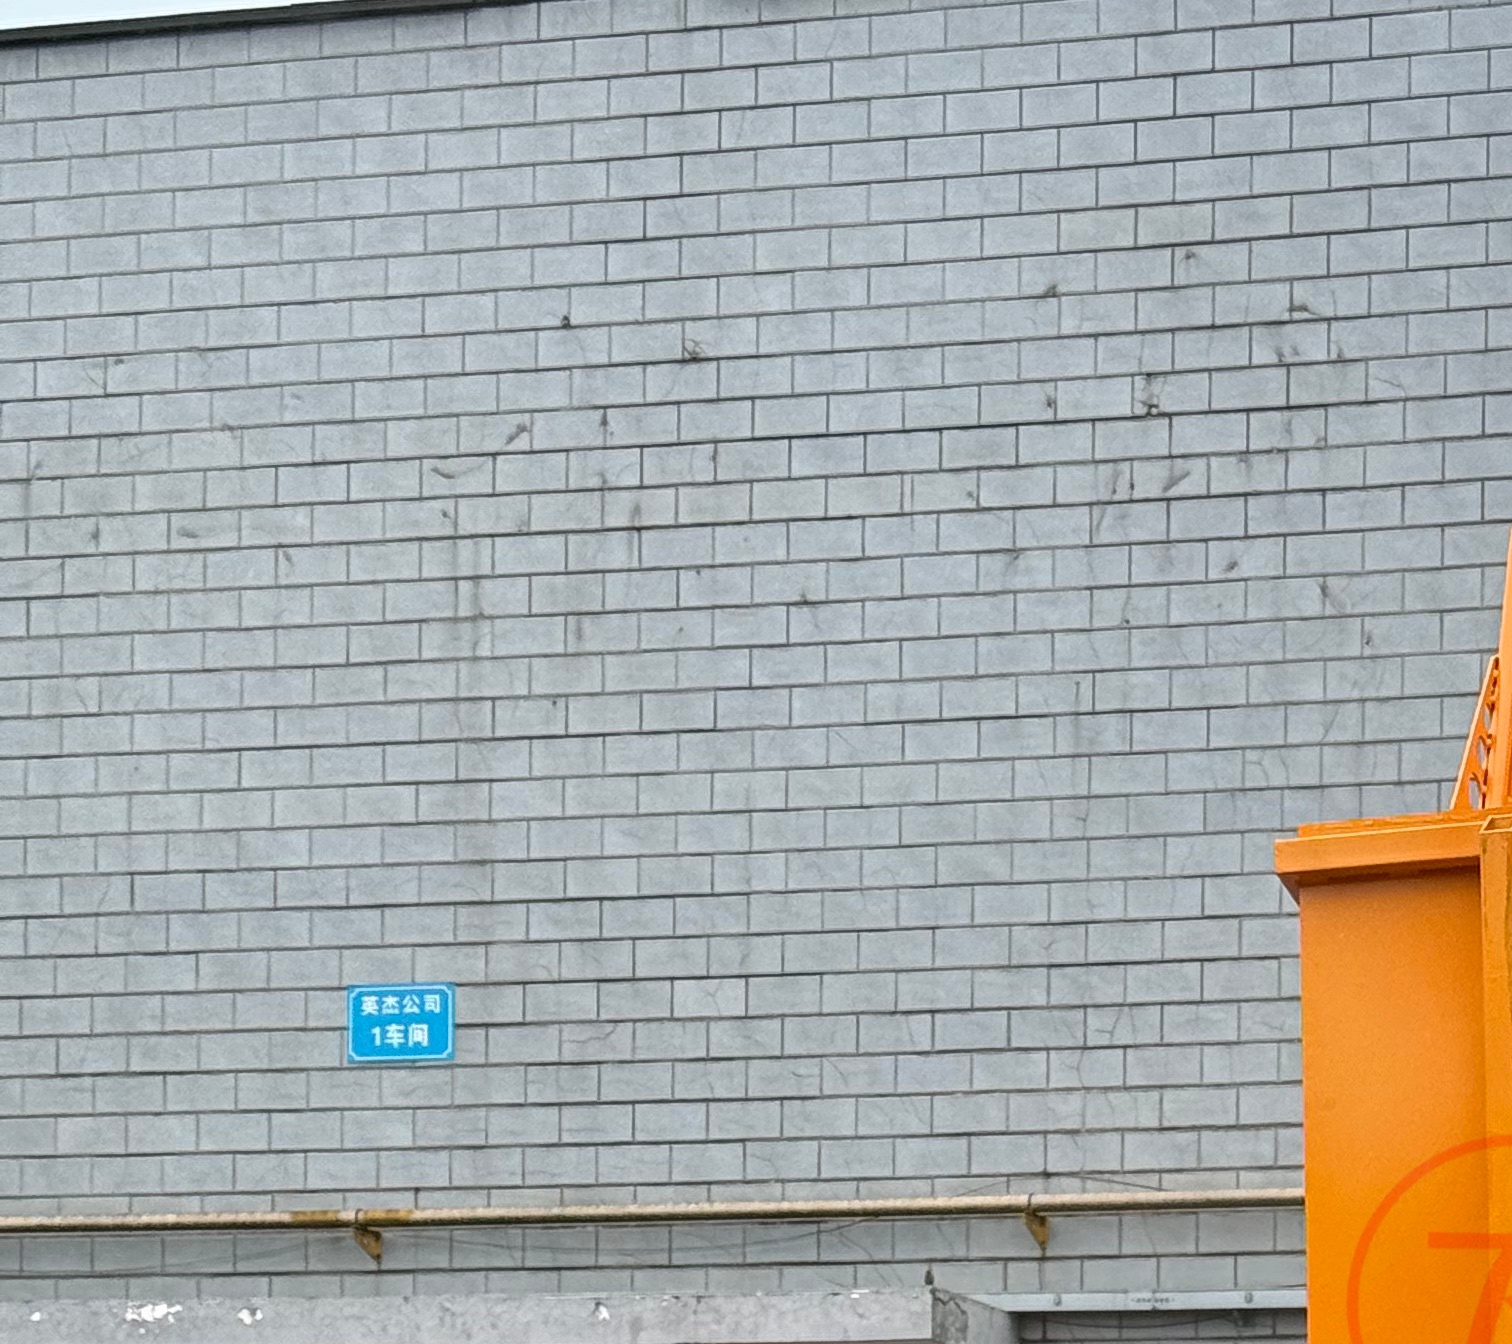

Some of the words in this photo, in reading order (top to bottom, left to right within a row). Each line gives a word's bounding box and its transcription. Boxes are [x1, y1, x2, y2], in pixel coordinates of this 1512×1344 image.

[360, 994, 441, 1016] 英杰公司
[370, 1023, 429, 1048] 1车间
